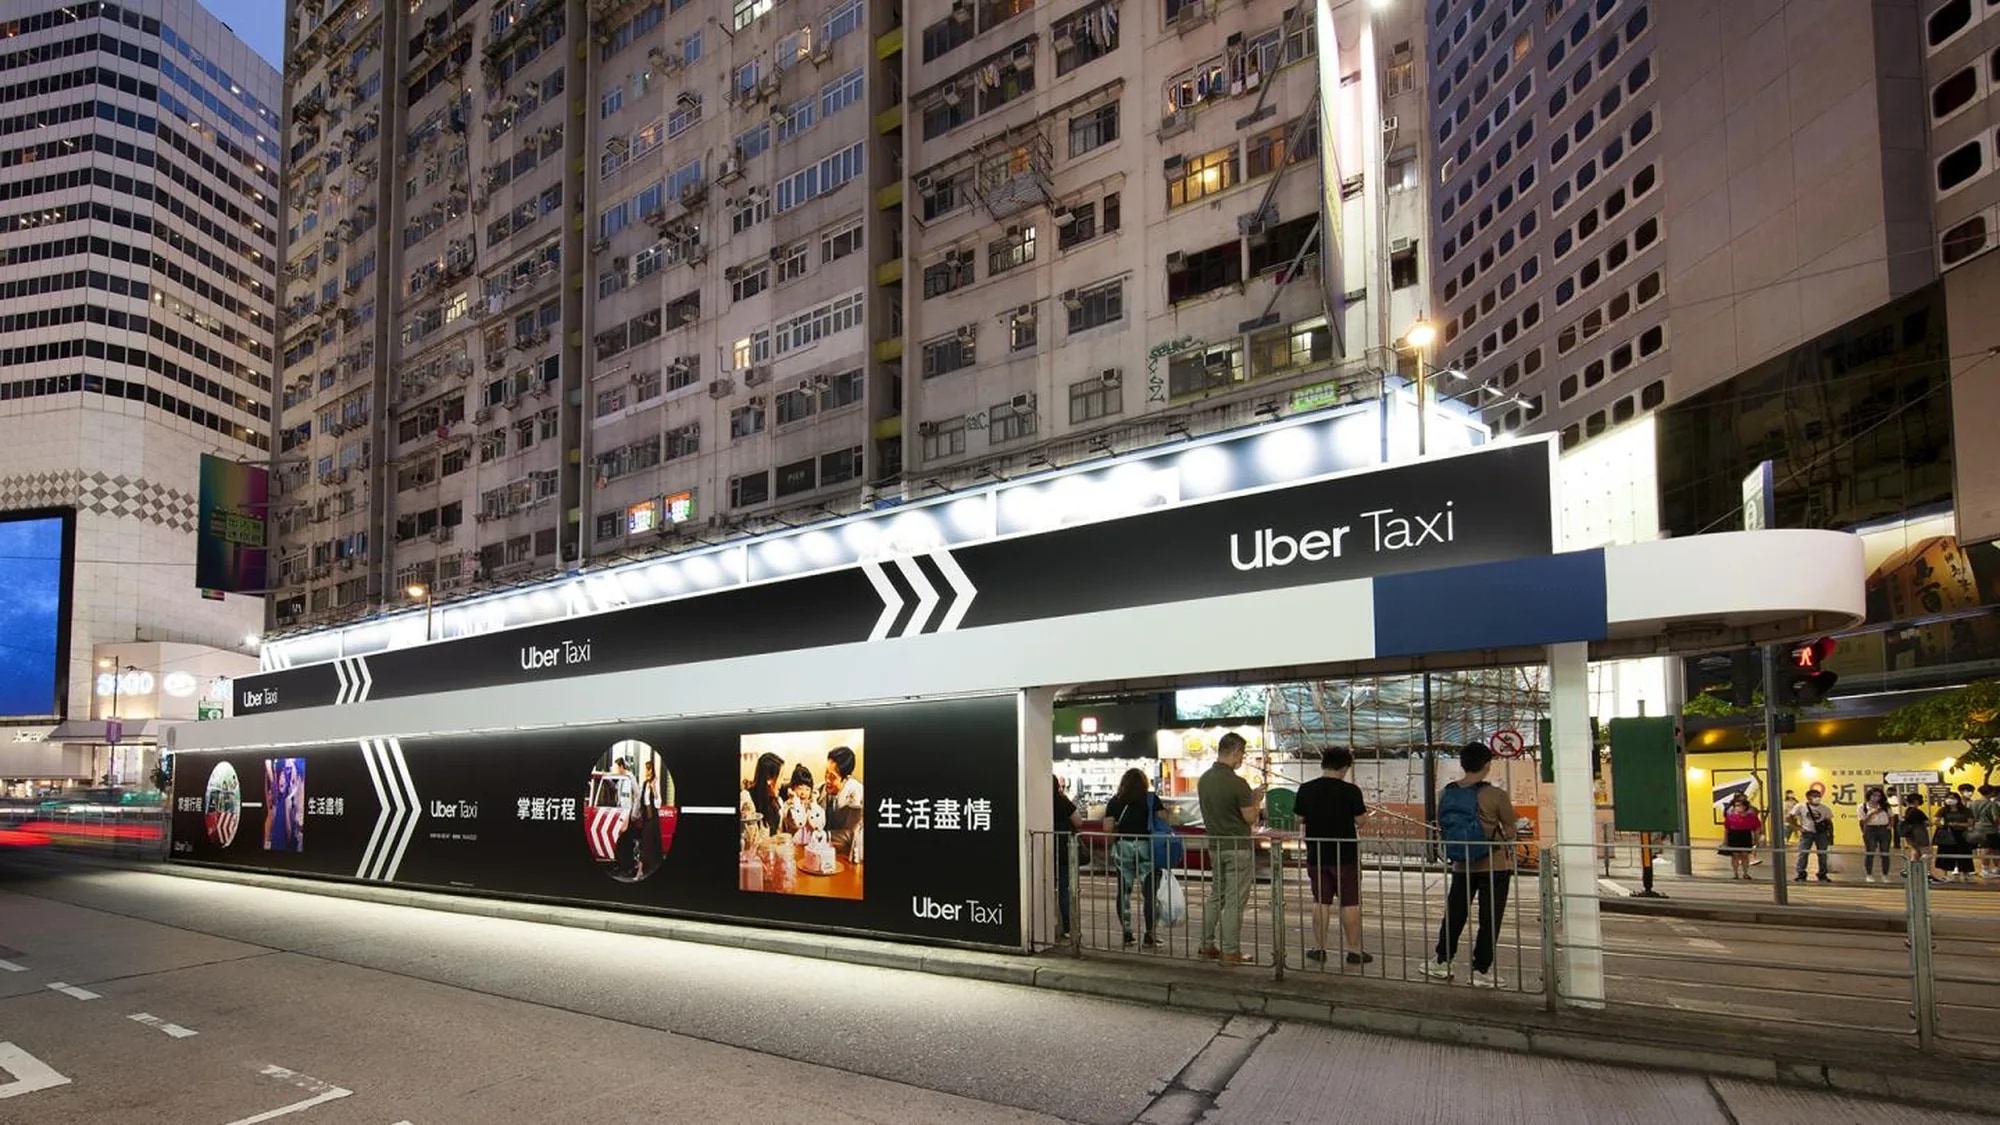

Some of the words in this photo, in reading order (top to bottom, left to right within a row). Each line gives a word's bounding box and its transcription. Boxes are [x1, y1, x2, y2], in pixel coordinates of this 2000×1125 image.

[1230, 525, 1350, 571] Uber
[1359, 500, 1455, 552] Taxi
[521, 645, 560, 670] Uber
[561, 638, 591, 664] Taxi
[243, 691, 263, 708] Uber
[263, 687, 278, 705] Taxi
[307, 797, 344, 816] 生活盡情
[430, 800, 458, 818] Uber
[458, 800, 478, 818] Taxi
[517, 797, 576, 821] 掌握行程
[878, 797, 992, 831] 生活盡情
[912, 896, 963, 921] Uber
[966, 899, 1003, 925] Taxi
